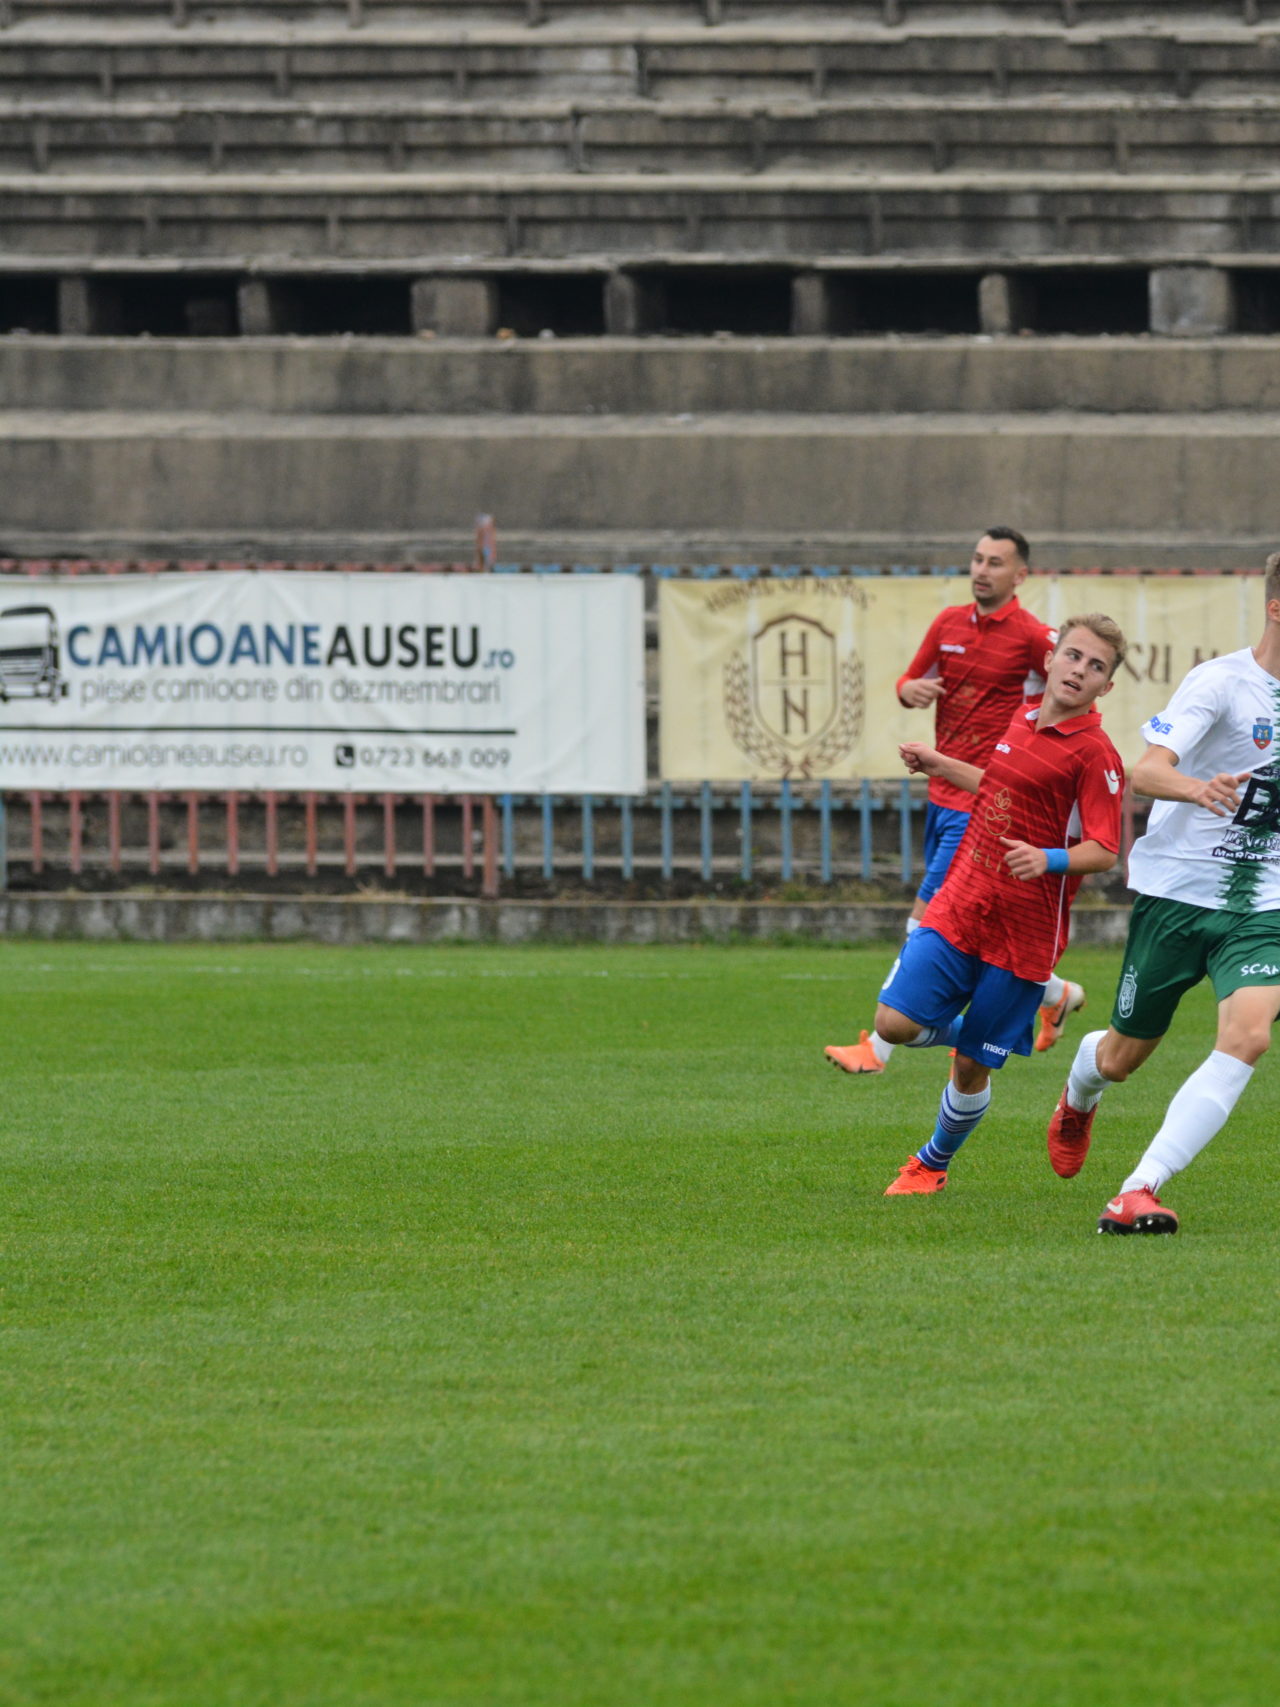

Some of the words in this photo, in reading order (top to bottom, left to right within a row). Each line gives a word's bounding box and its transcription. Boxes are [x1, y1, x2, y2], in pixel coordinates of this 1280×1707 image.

[81, 675, 146, 707] piese
[285, 674, 323, 703] din
[469, 747, 511, 769] 009
